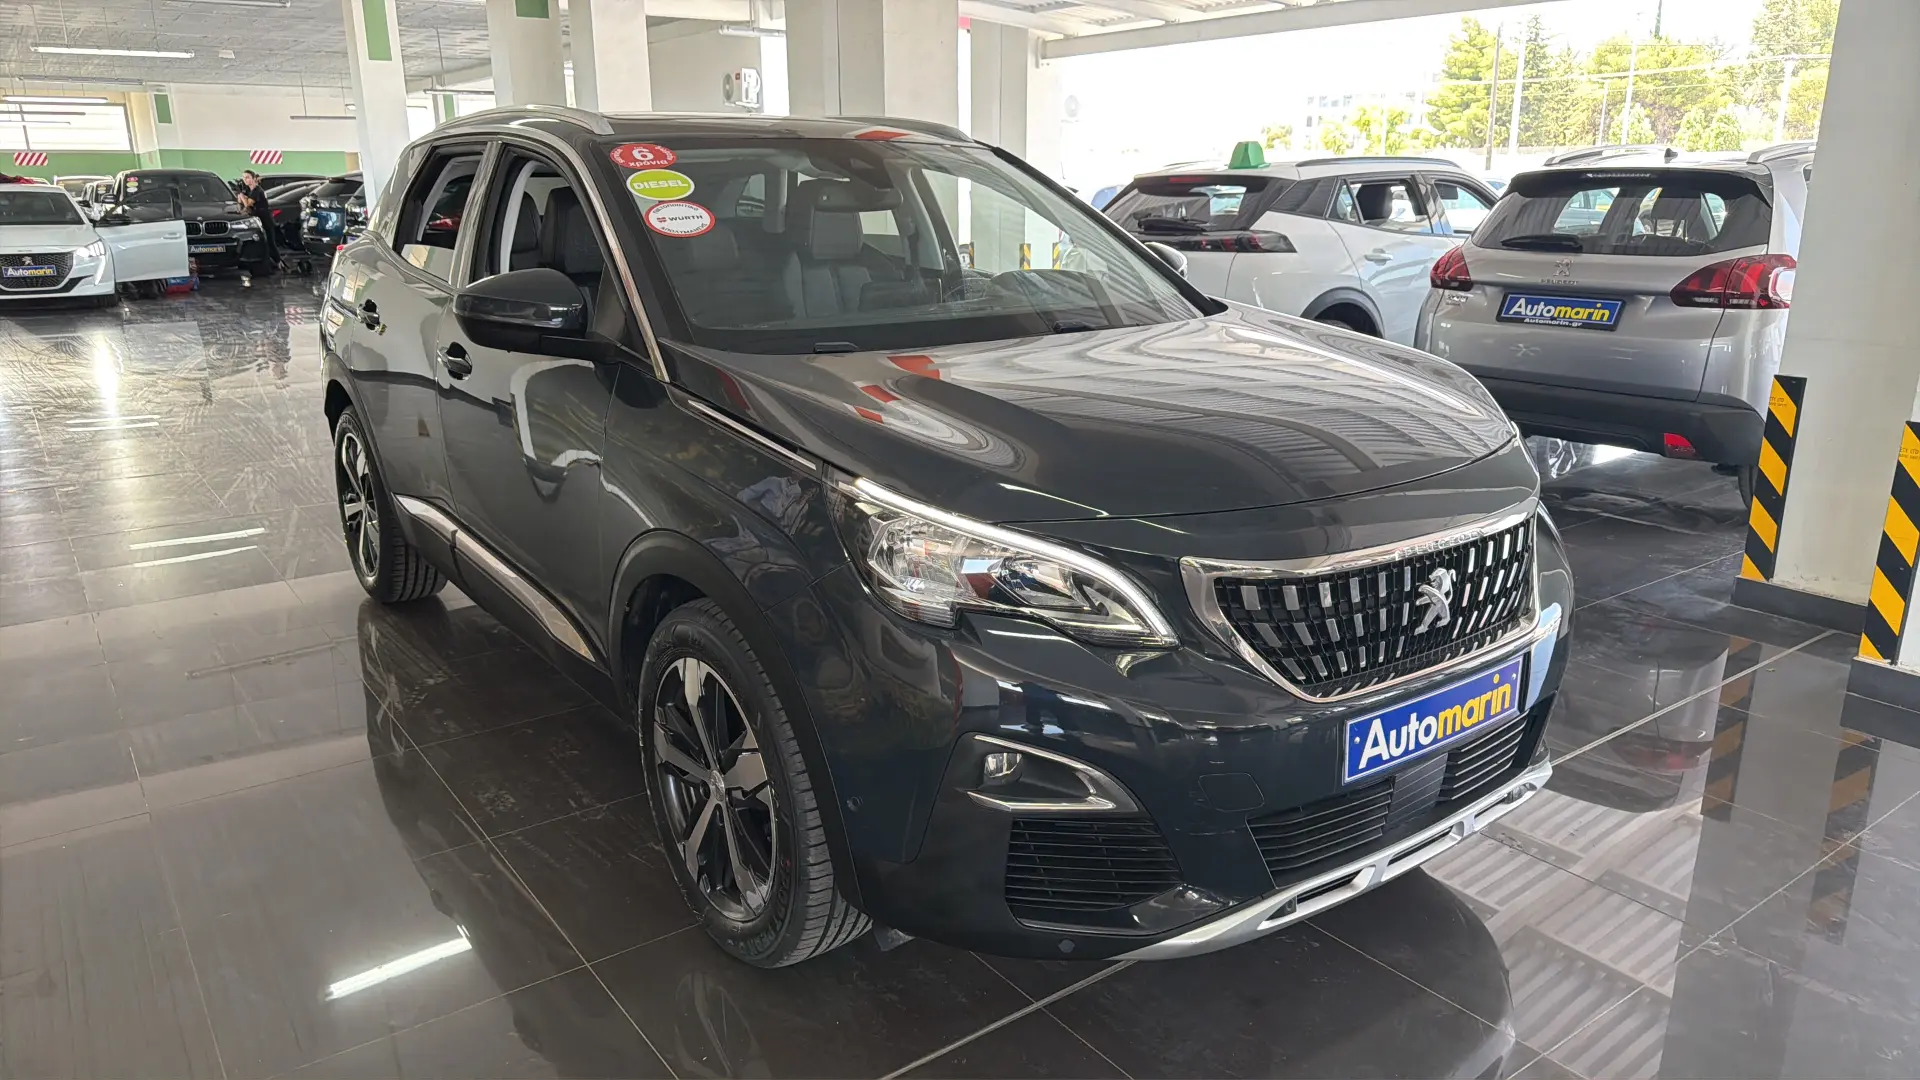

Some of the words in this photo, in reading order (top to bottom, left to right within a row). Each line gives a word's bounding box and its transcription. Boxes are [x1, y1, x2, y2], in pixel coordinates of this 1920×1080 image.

[632, 148, 654, 160] 6
[633, 179, 689, 190] DIESEL
[191, 245, 224, 253] Automarin
[7, 266, 53, 276] Automarin
[1508, 297, 1610, 321] Automarin
[1523, 317, 1583, 327] Automarin.gr
[1358, 673, 1511, 770] Automarin
